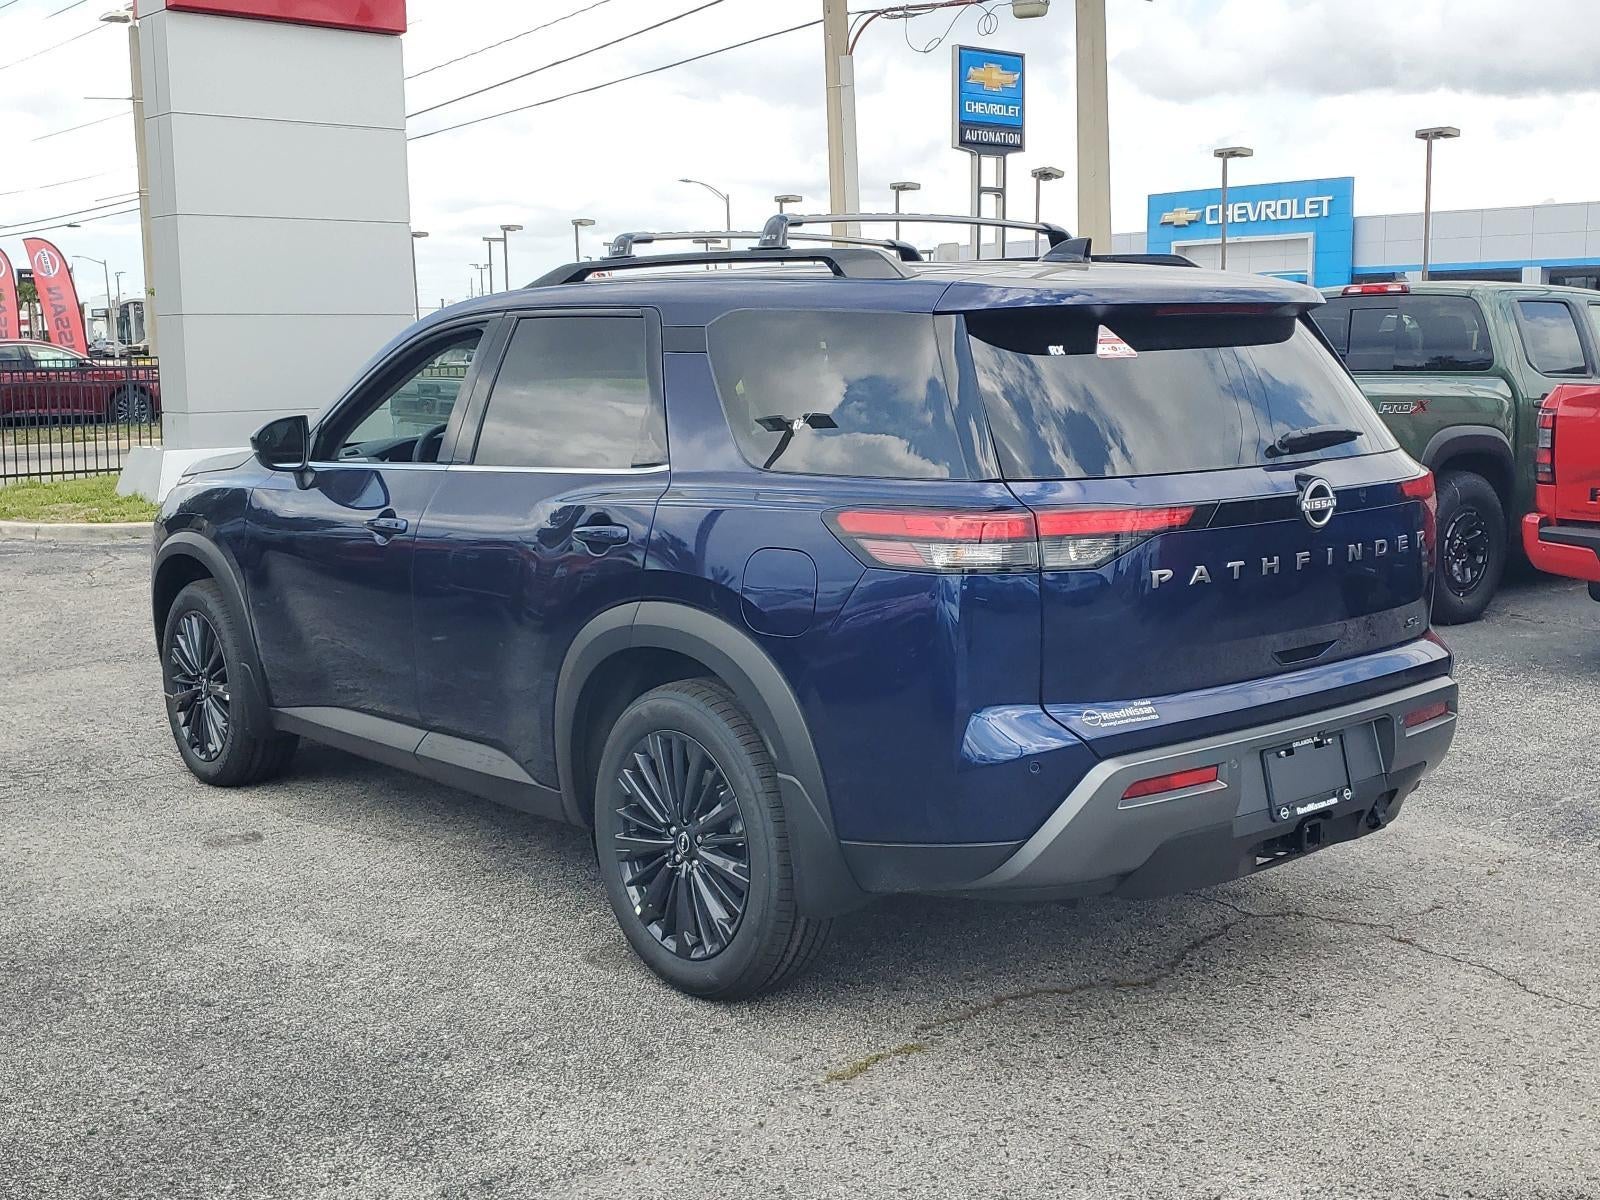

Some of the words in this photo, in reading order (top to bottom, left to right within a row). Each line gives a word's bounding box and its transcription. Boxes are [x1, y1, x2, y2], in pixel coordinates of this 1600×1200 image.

[965, 101, 1020, 117] CHEVROLET
[965, 129, 1021, 145] AUTONATION
[1205, 195, 1333, 225] CHEVROLET
[1303, 499, 1337, 509] NISSAN
[1150, 530, 1426, 589] PATHFINDER
[1404, 615, 1420, 628] SL
